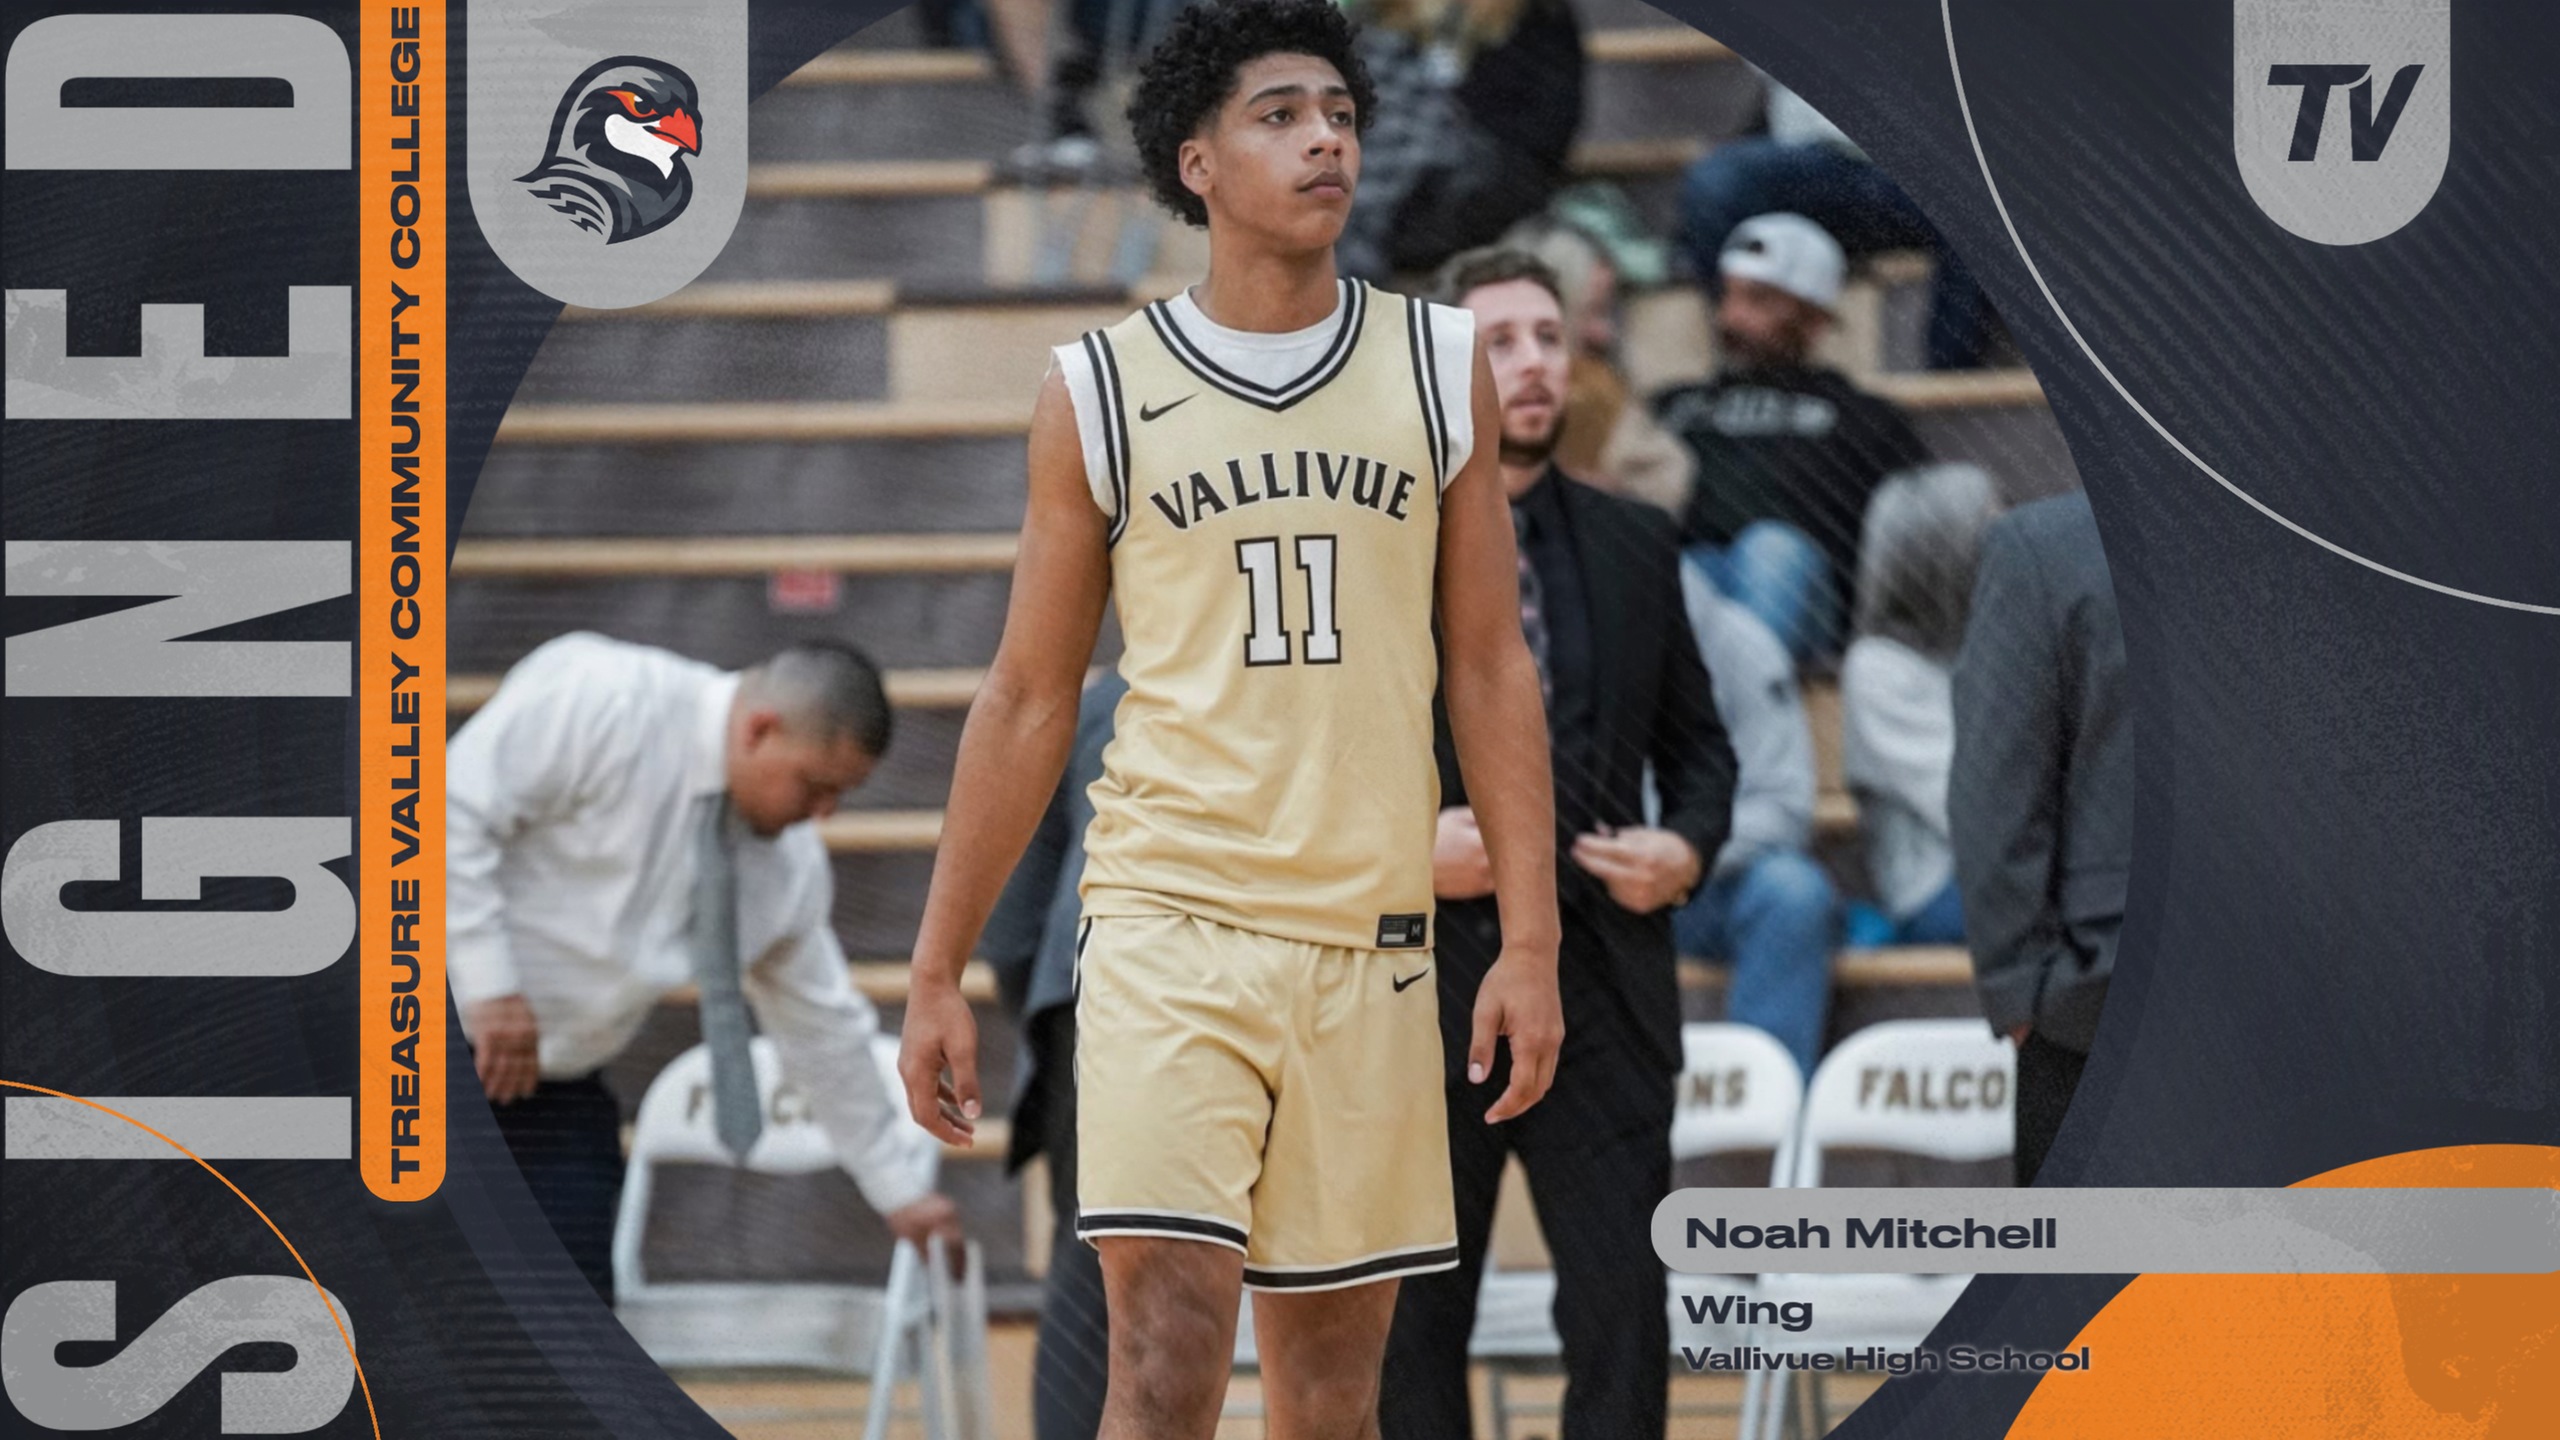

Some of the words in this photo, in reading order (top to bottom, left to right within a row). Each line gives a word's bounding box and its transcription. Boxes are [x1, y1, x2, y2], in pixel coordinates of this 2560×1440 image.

[1149, 450, 1417, 530] VALLIVUE
[1235, 534, 1342, 667] 11
[1859, 1067, 2006, 1110] FALCO
